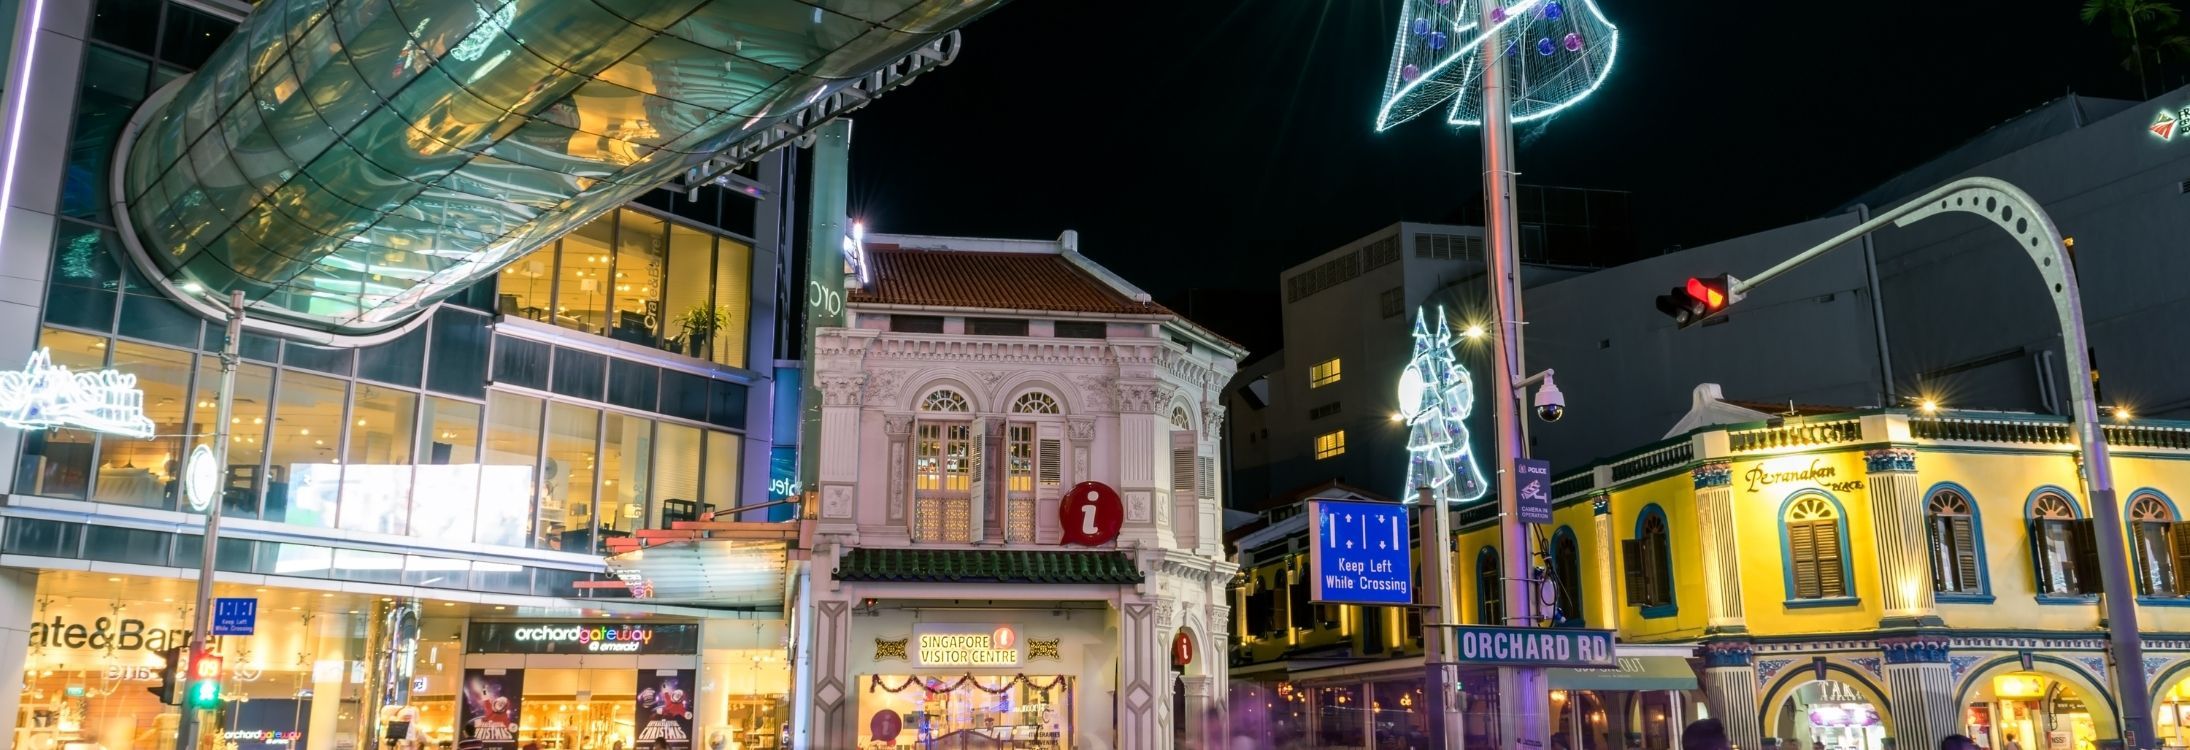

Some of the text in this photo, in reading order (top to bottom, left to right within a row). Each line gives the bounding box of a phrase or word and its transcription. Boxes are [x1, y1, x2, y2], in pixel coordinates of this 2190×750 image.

[1745, 459, 1836, 492] Peranakan
[1832, 481, 1865, 492] PLACE
[1338, 557, 1392, 575] Keep Left
[1326, 575, 1407, 594] While Crossing
[515, 625, 652, 645] orchardgateway
[921, 636, 989, 648] SINGAPORE
[600, 641, 640, 652] emerald
[1463, 632, 1570, 662] ORCHARD
[921, 650, 1016, 663] VISITOR CENTRE
[1617, 658, 1645, 673] OUT
